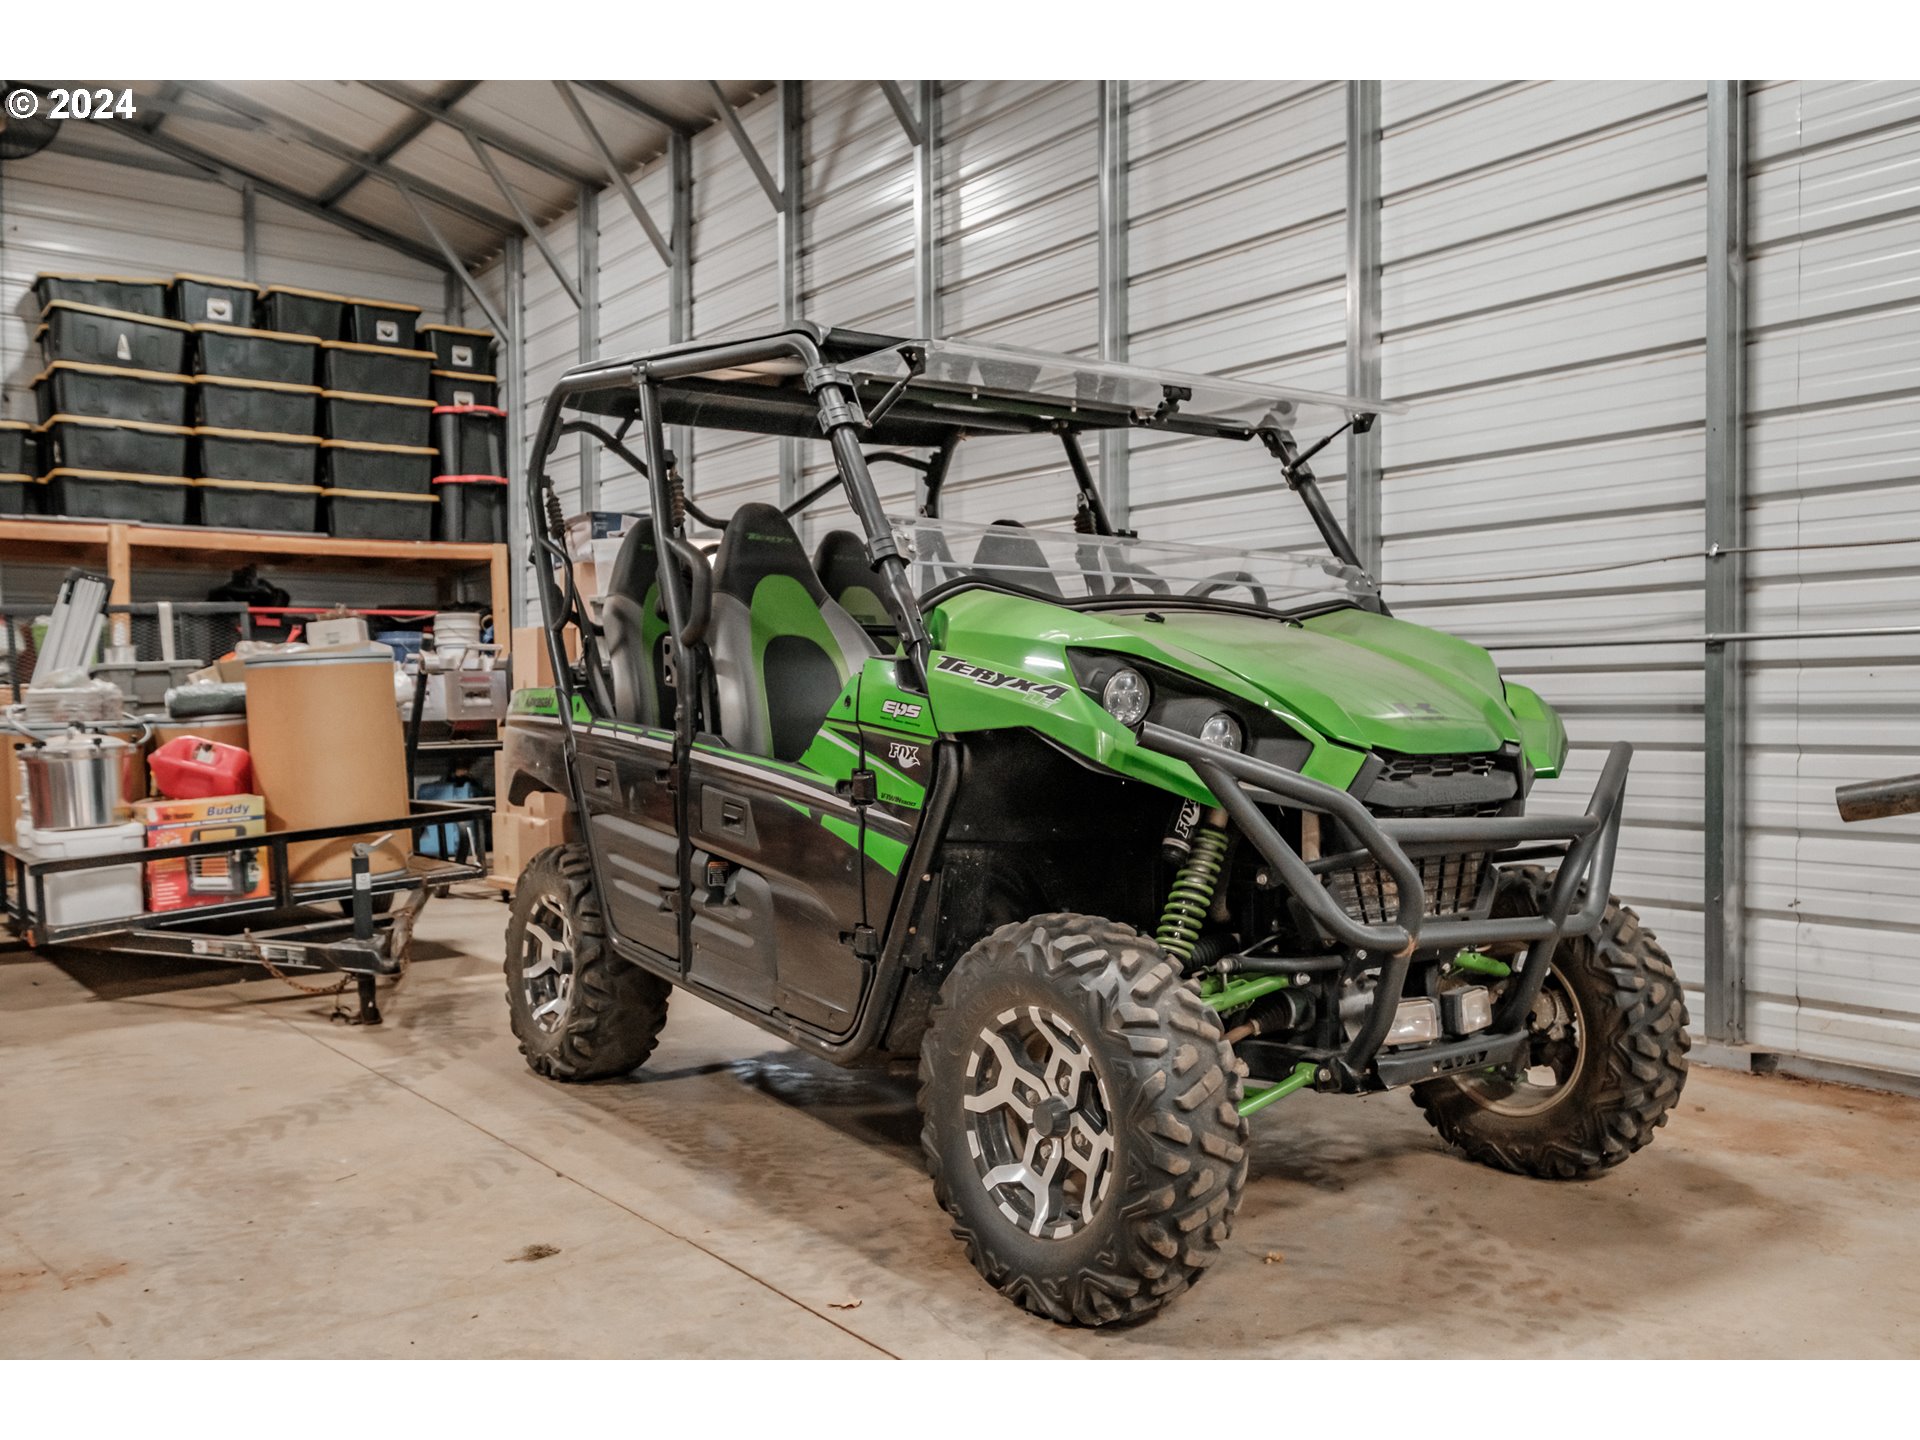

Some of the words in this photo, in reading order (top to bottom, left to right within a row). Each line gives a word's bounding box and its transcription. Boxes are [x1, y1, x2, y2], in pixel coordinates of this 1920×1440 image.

[888, 742, 920, 766] FOX
[206, 804, 250, 817] Buddy
[1175, 798, 1200, 839] FOX
